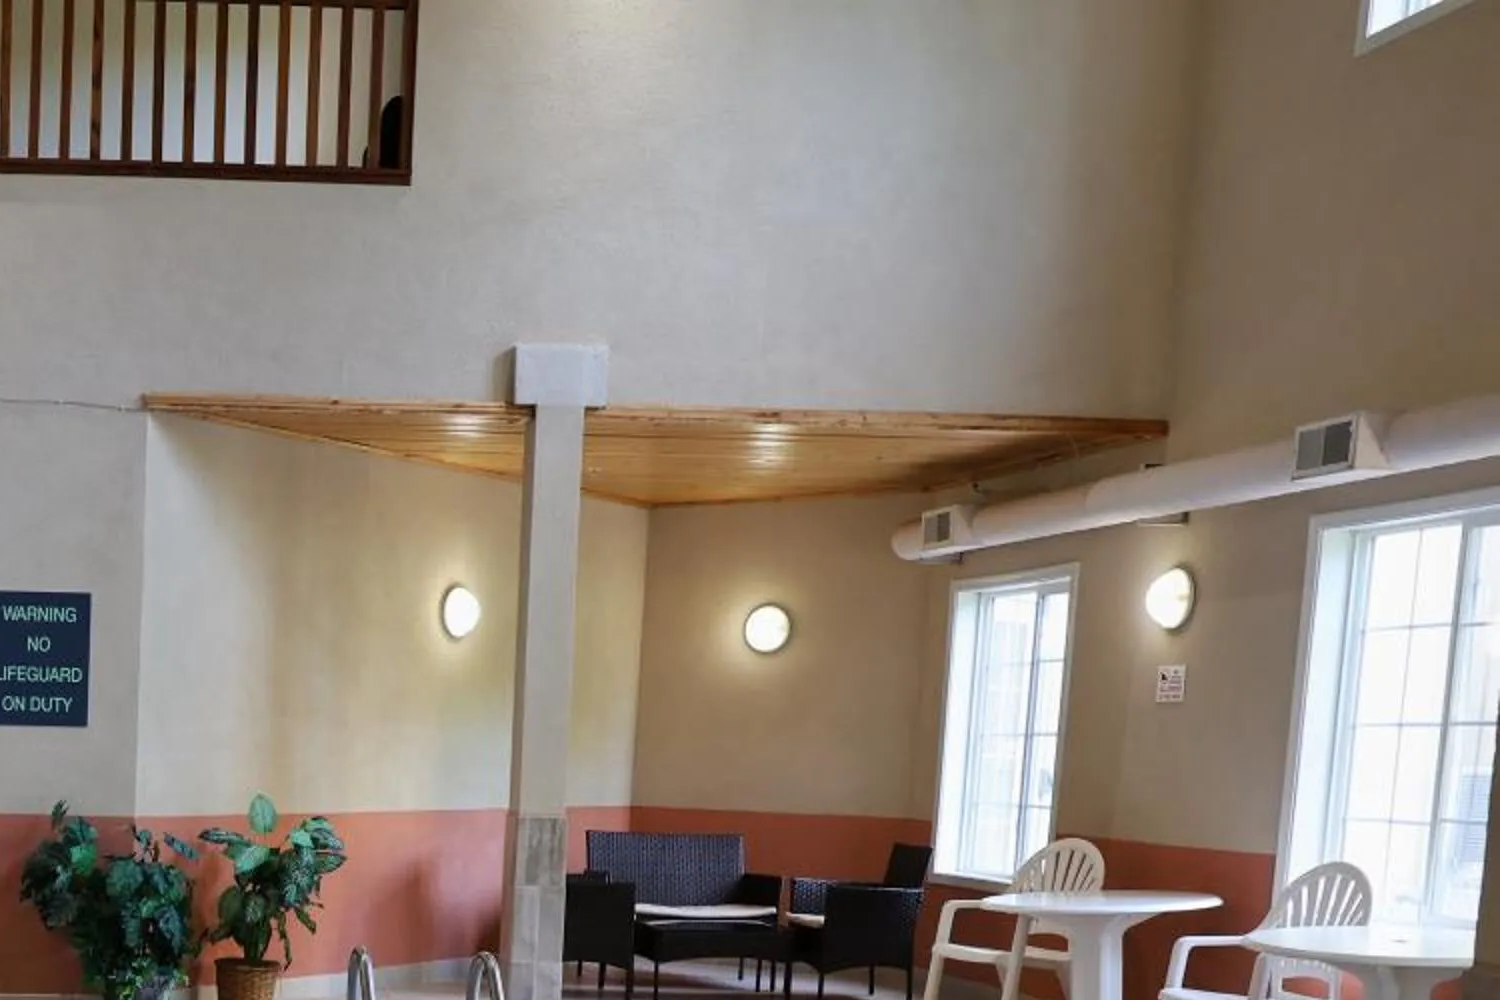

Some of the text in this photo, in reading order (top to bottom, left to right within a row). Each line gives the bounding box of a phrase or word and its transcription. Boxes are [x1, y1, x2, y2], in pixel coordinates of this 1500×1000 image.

[2, 605, 77, 622] WARNING
[27, 636, 51, 653] NO
[1, 695, 73, 712] ON DUTY
